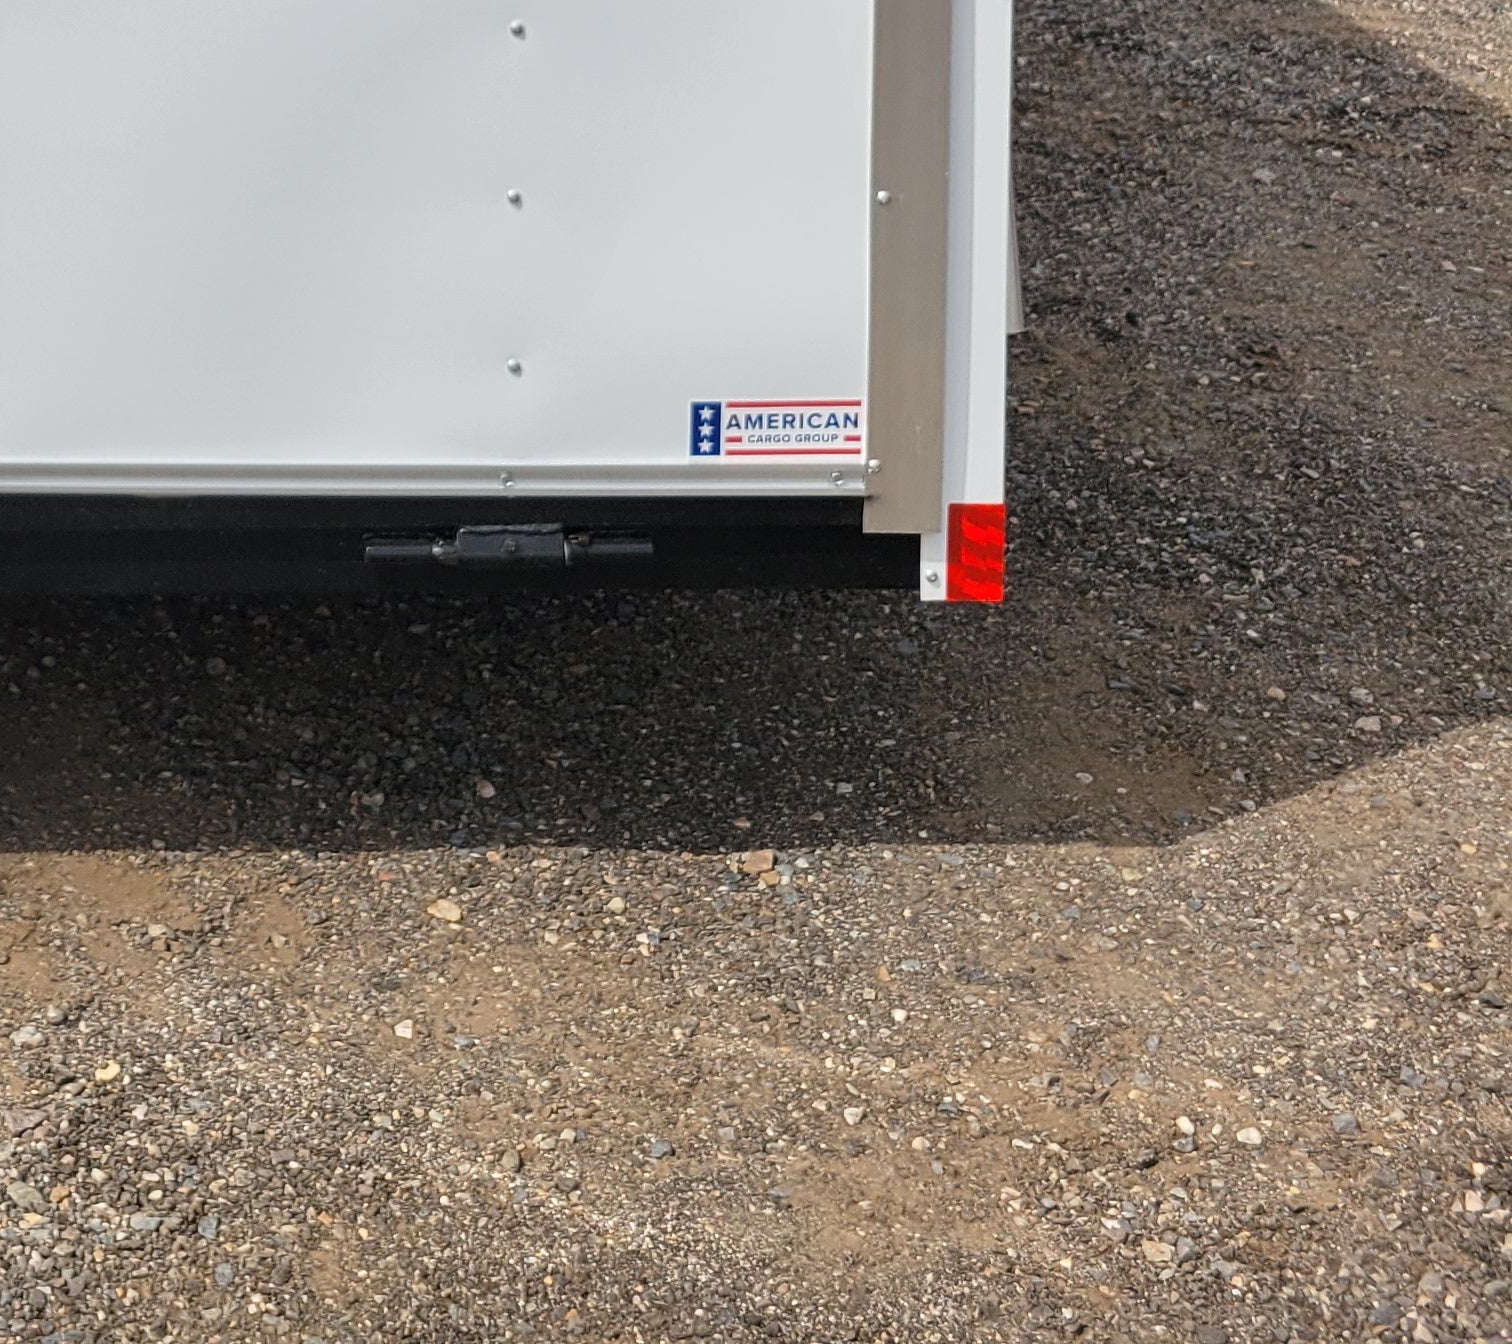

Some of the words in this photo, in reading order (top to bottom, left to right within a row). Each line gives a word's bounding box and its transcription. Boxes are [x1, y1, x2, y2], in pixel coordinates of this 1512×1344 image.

[725, 412, 859, 430] AMERICAN
[747, 434, 791, 443] CARGO
[795, 433, 839, 443] GROUP
